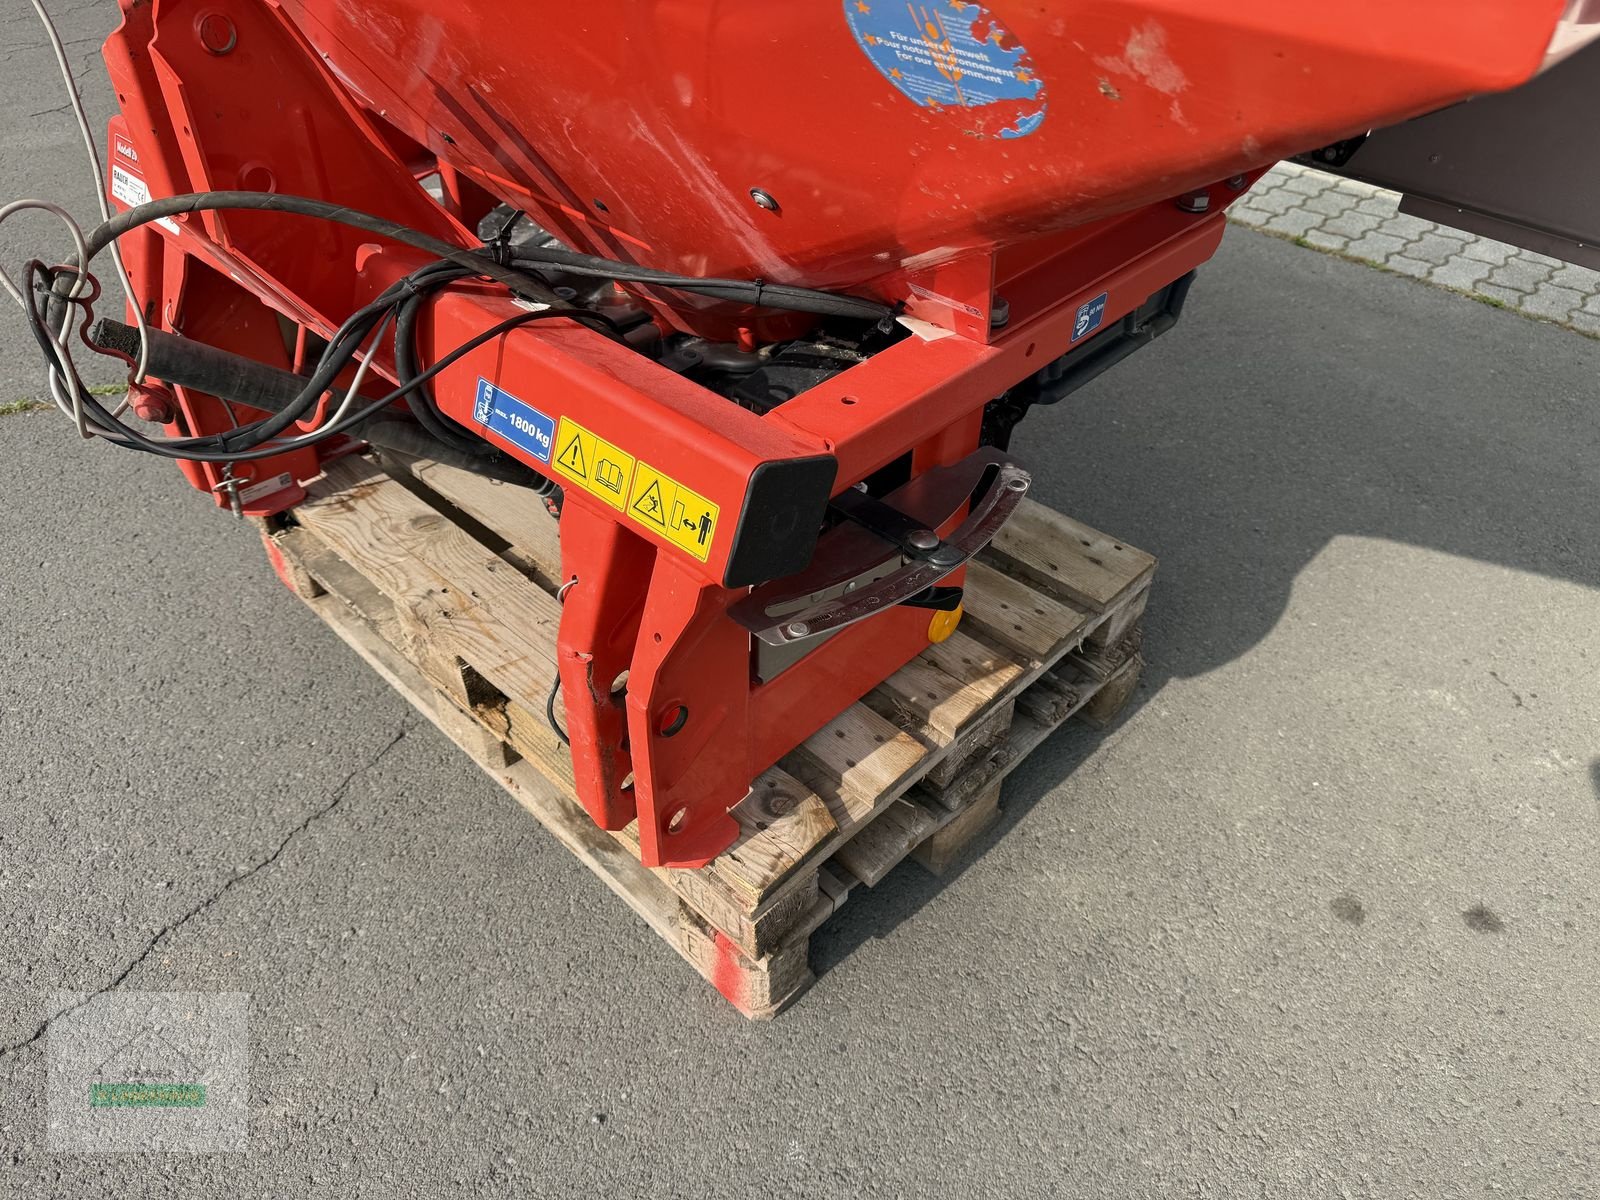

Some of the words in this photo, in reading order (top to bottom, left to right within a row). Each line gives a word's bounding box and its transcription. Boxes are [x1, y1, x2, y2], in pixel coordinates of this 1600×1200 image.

[876, 37, 901, 50] Pour
[902, 43, 930, 57] notre
[931, 49, 1016, 79] environnement
[889, 31, 910, 42] Für
[910, 36, 948, 51] unsere
[948, 44, 991, 63] Umwelt
[895, 50, 913, 62] For
[914, 56, 932, 66] our
[933, 59, 1003, 85] environment
[494, 408, 508, 421] max.
[509, 412, 536, 438] 1800
[535, 427, 550, 449] kg
